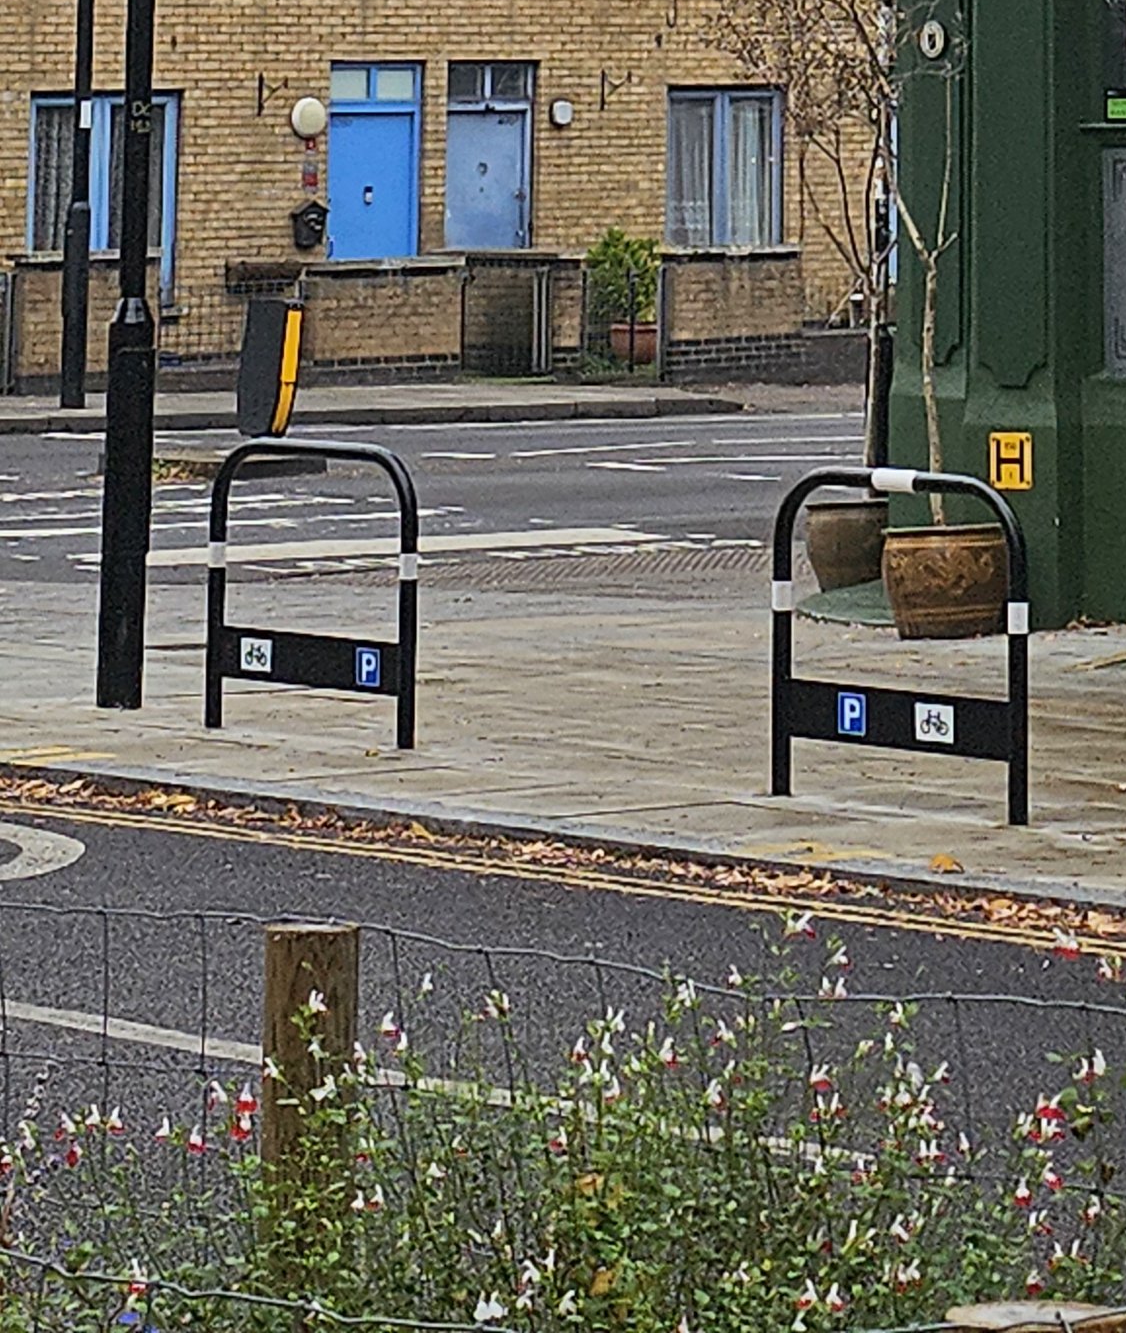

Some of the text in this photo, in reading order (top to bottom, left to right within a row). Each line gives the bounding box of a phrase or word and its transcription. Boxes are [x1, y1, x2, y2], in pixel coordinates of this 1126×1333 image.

[996, 437, 1025, 483] H
[361, 652, 377, 682] P
[843, 697, 861, 731] P
